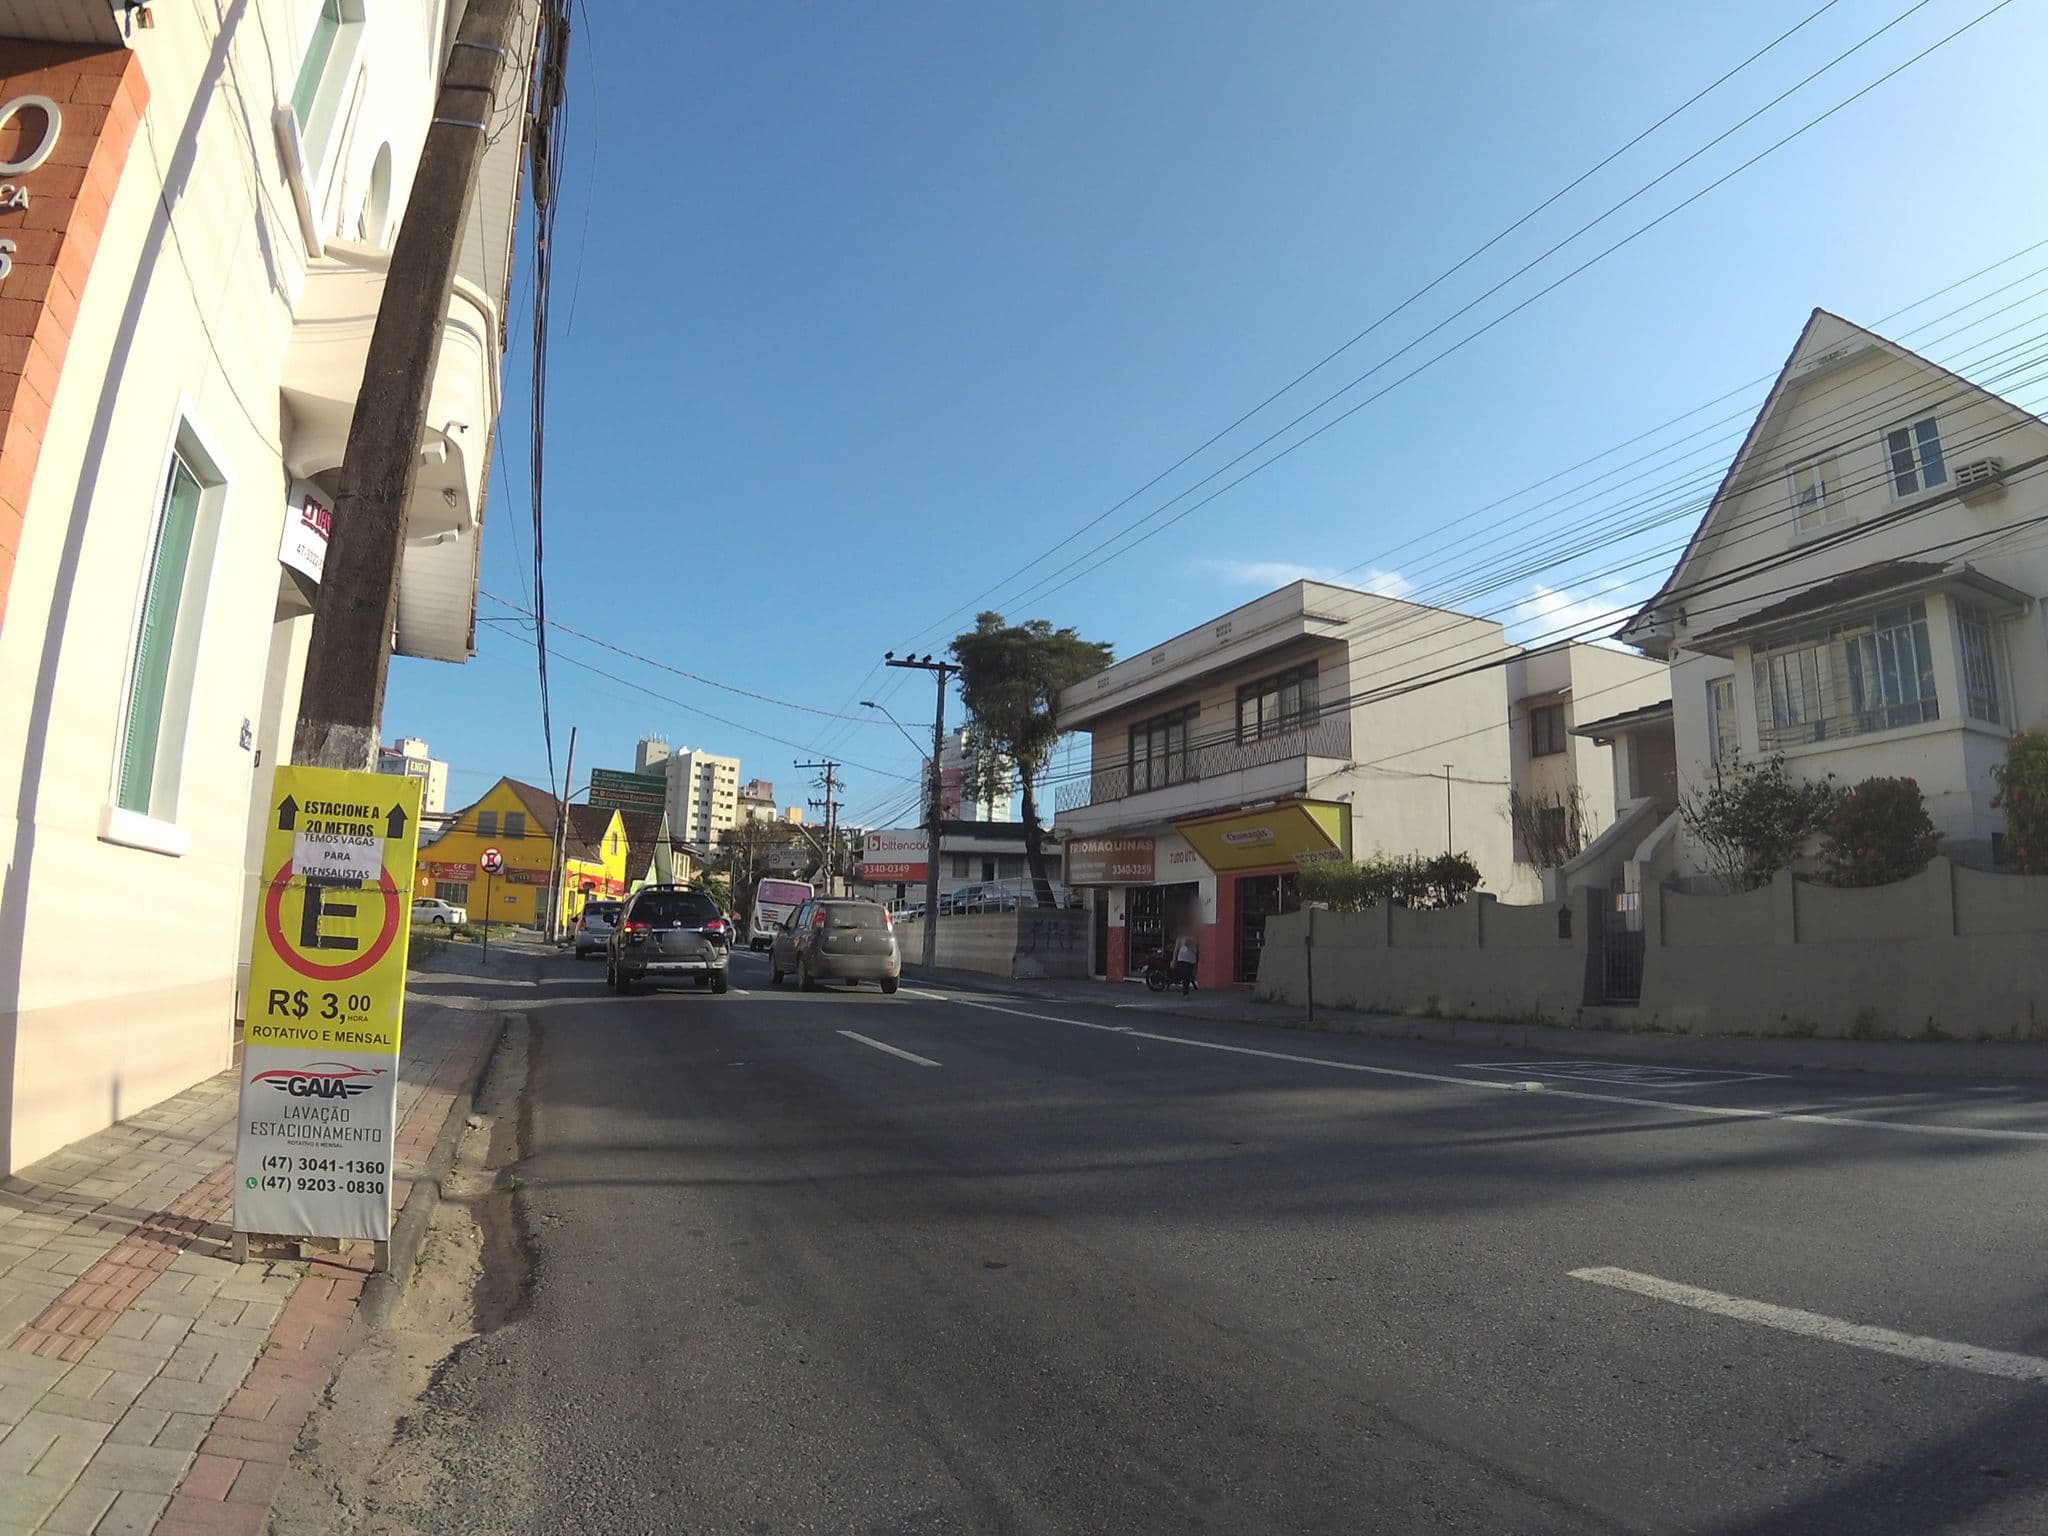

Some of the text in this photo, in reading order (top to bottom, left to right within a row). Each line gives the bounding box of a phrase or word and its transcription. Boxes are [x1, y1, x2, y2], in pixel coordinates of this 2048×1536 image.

[304, 800, 380, 819] ESTACIONE A
[305, 819, 374, 838] 20 METROS
[304, 833, 375, 847] TEMOS VAGAS
[1070, 839, 1154, 854] FRIOMAQUINAS
[323, 851, 351, 861] PARA
[301, 866, 370, 879] MENSALISTAS
[863, 864, 910, 873] 3340-0349
[299, 876, 362, 950] E
[267, 989, 371, 1025] R$ 3,00
[347, 1014, 369, 1022] HORA
[252, 1025, 391, 1045] ROTATIVO E MENSAL
[287, 1076, 348, 1100] GAIA
[283, 1105, 350, 1124] LAVAÇÃO
[250, 1121, 382, 1143] ESTACIONAMENTO
[262, 1155, 385, 1175] (47) 3041-1360
[261, 1175, 384, 1195] (47) 9203-0830
